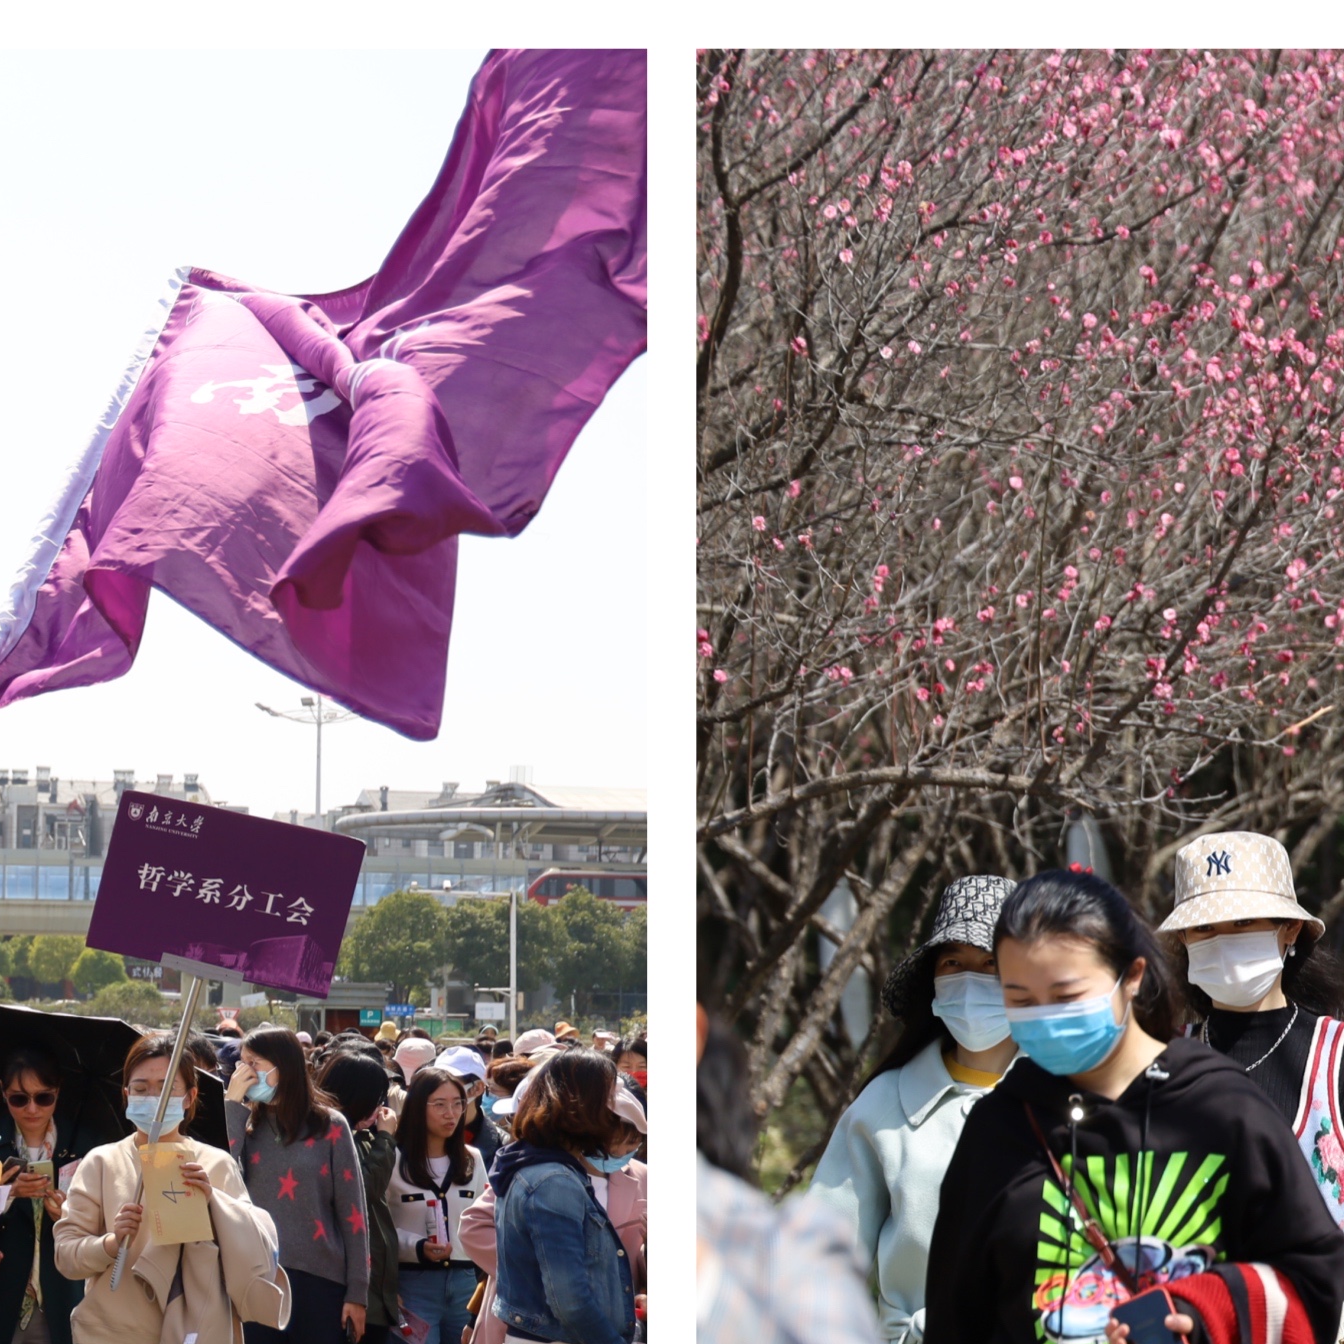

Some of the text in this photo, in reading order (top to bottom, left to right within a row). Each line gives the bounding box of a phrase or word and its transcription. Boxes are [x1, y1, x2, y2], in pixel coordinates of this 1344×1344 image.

[137, 863, 315, 926] 哲学系分工会
